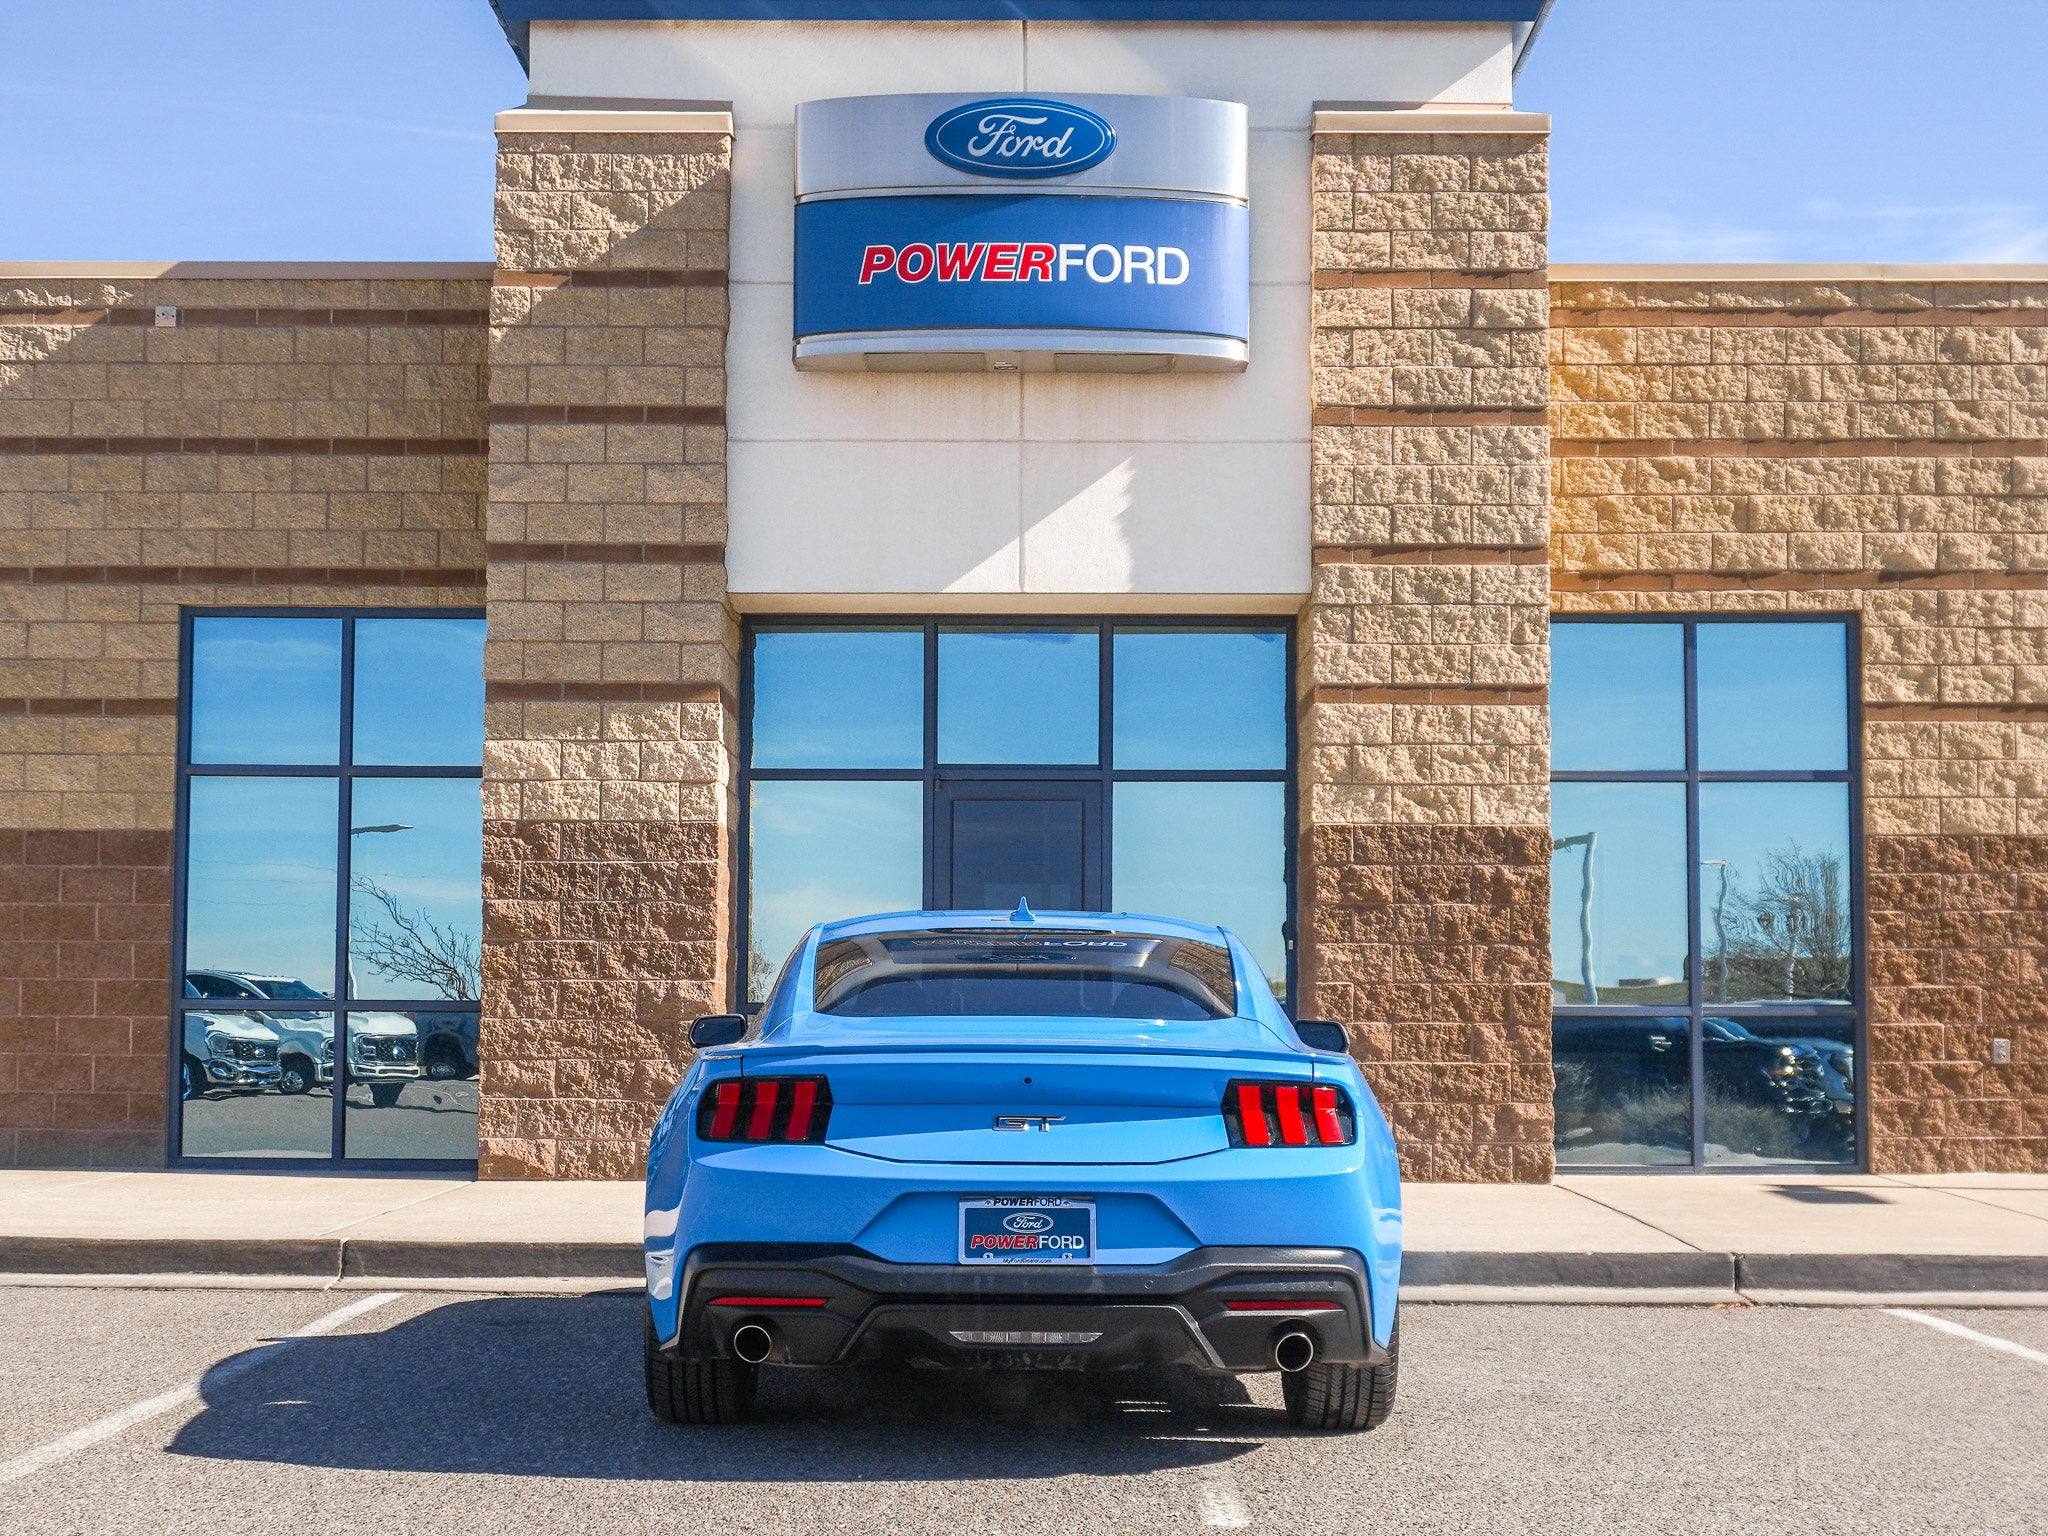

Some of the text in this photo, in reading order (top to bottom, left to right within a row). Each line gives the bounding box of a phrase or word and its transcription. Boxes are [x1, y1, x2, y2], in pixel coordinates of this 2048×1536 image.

[967, 114, 1073, 158] Ford
[858, 242, 1190, 285] POWERFORD
[993, 1115, 1066, 1132] GT
[993, 1197, 1062, 1207] POWERFORD
[1013, 1216, 1043, 1229] Ford
[970, 1235, 1085, 1250] POWERFORD
